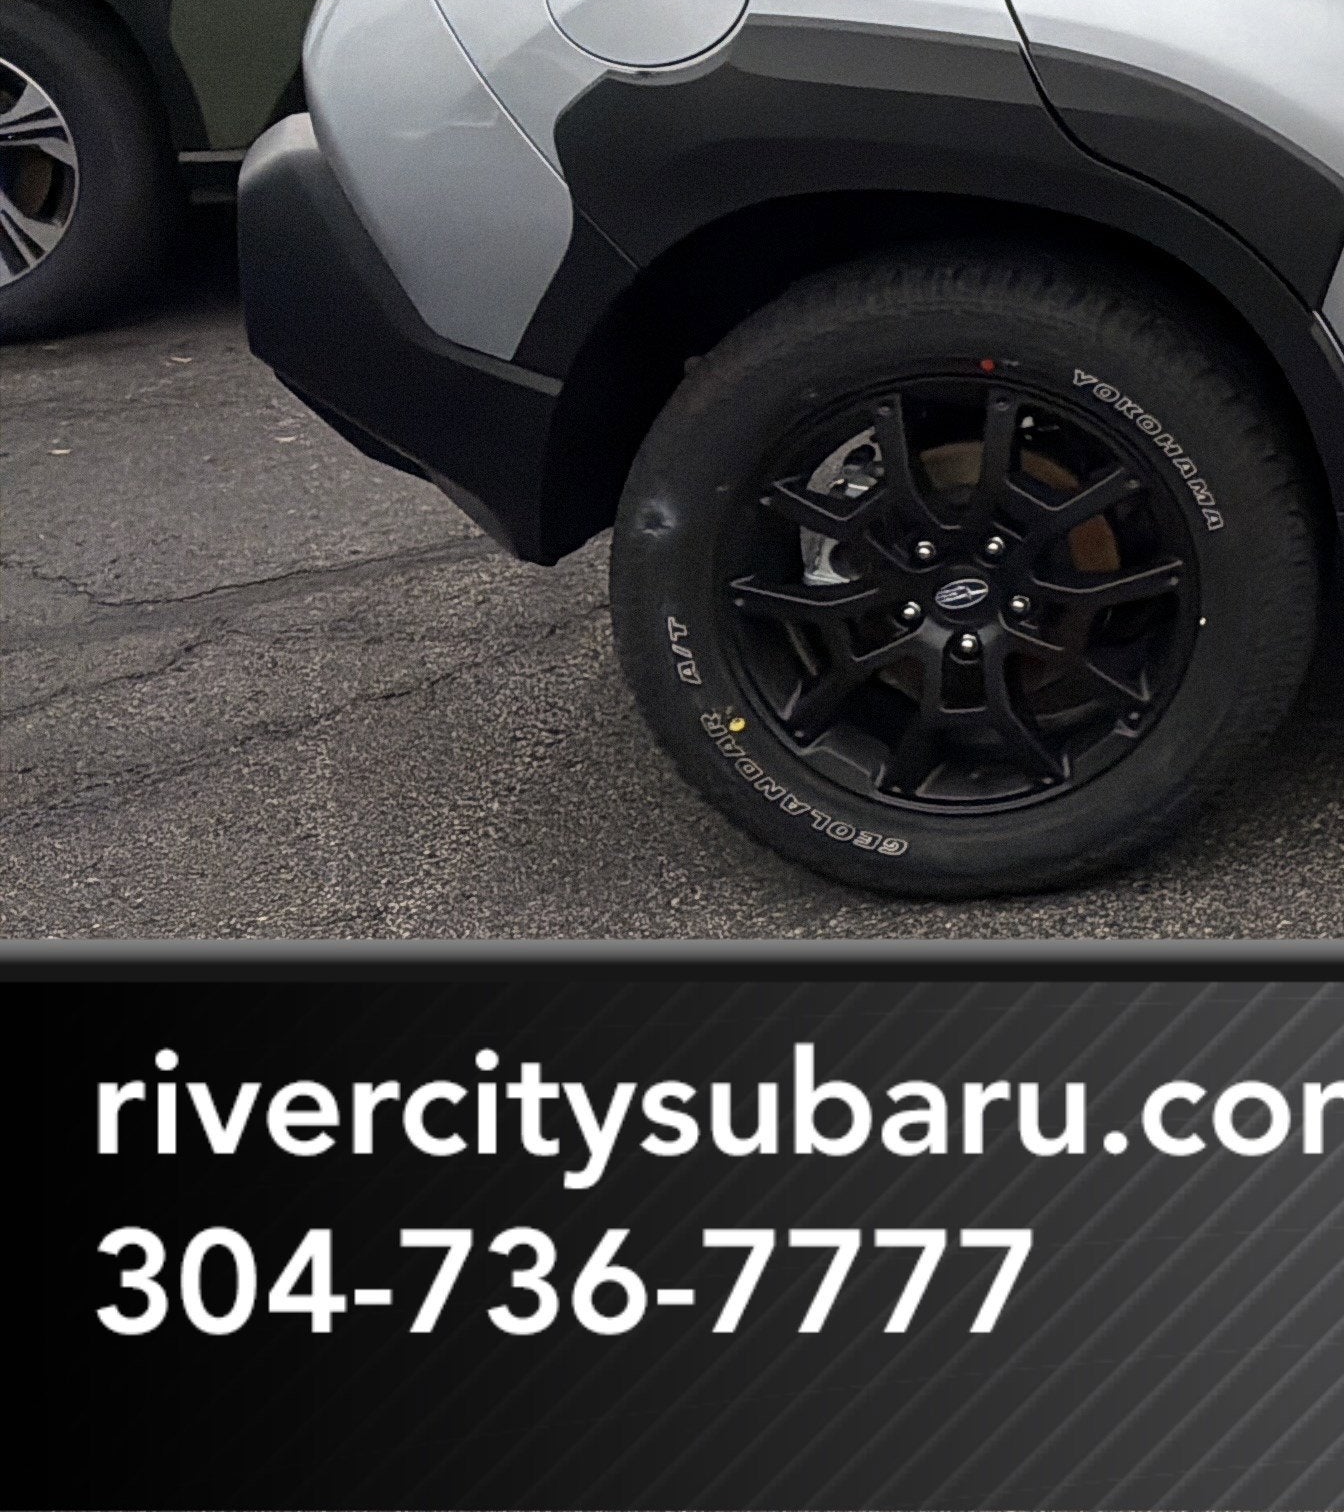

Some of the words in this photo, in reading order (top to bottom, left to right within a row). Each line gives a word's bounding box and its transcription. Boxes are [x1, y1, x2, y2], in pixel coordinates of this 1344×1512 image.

[1072, 368, 1225, 531] YOKOHAMA
[667, 616, 702, 685] A/T
[700, 712, 909, 857] GEOLANDAR
